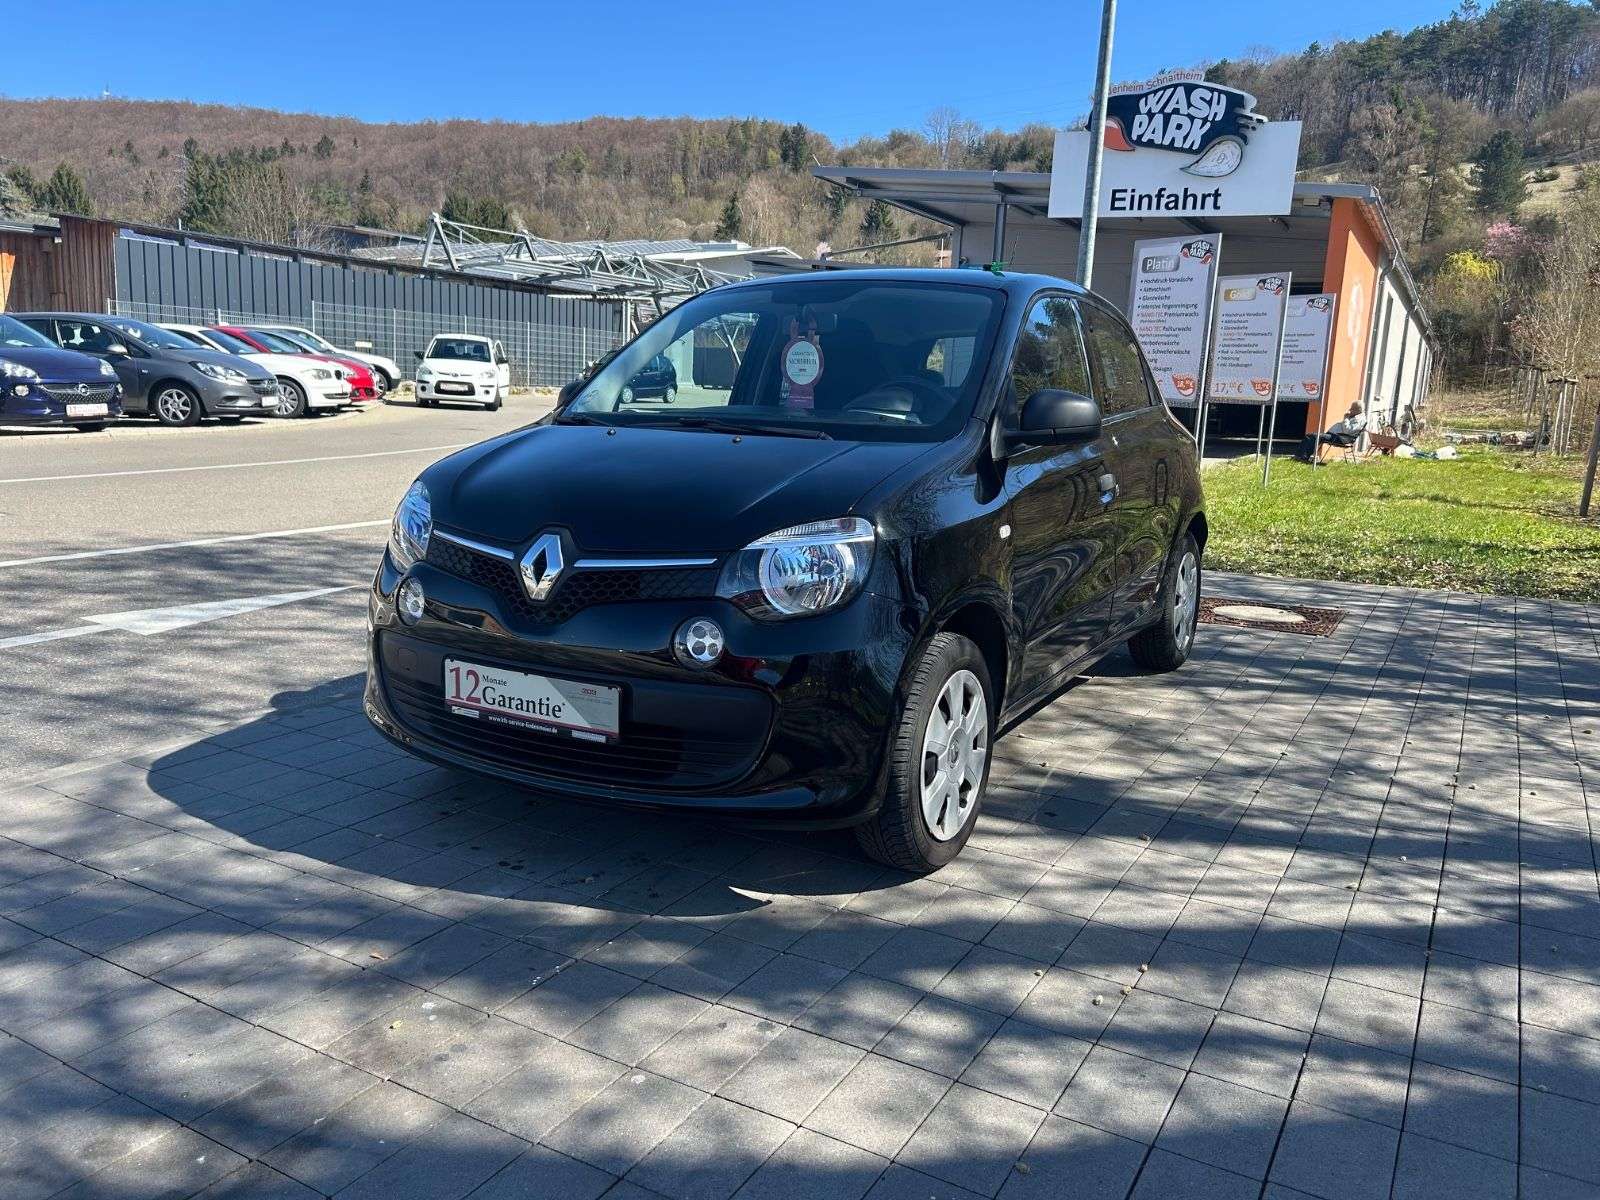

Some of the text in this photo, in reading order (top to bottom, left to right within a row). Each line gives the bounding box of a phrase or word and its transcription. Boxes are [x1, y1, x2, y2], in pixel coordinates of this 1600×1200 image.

[1146, 70, 1203, 89] Schnaitheim
[1139, 85, 1227, 122] WASH
[1131, 113, 1211, 150] PARK
[1110, 186, 1222, 211] Einfahrt
[1191, 240, 1210, 251] WASH
[1146, 257, 1175, 271] Platin
[449, 666, 481, 704] 12
[482, 674, 508, 687] Monate
